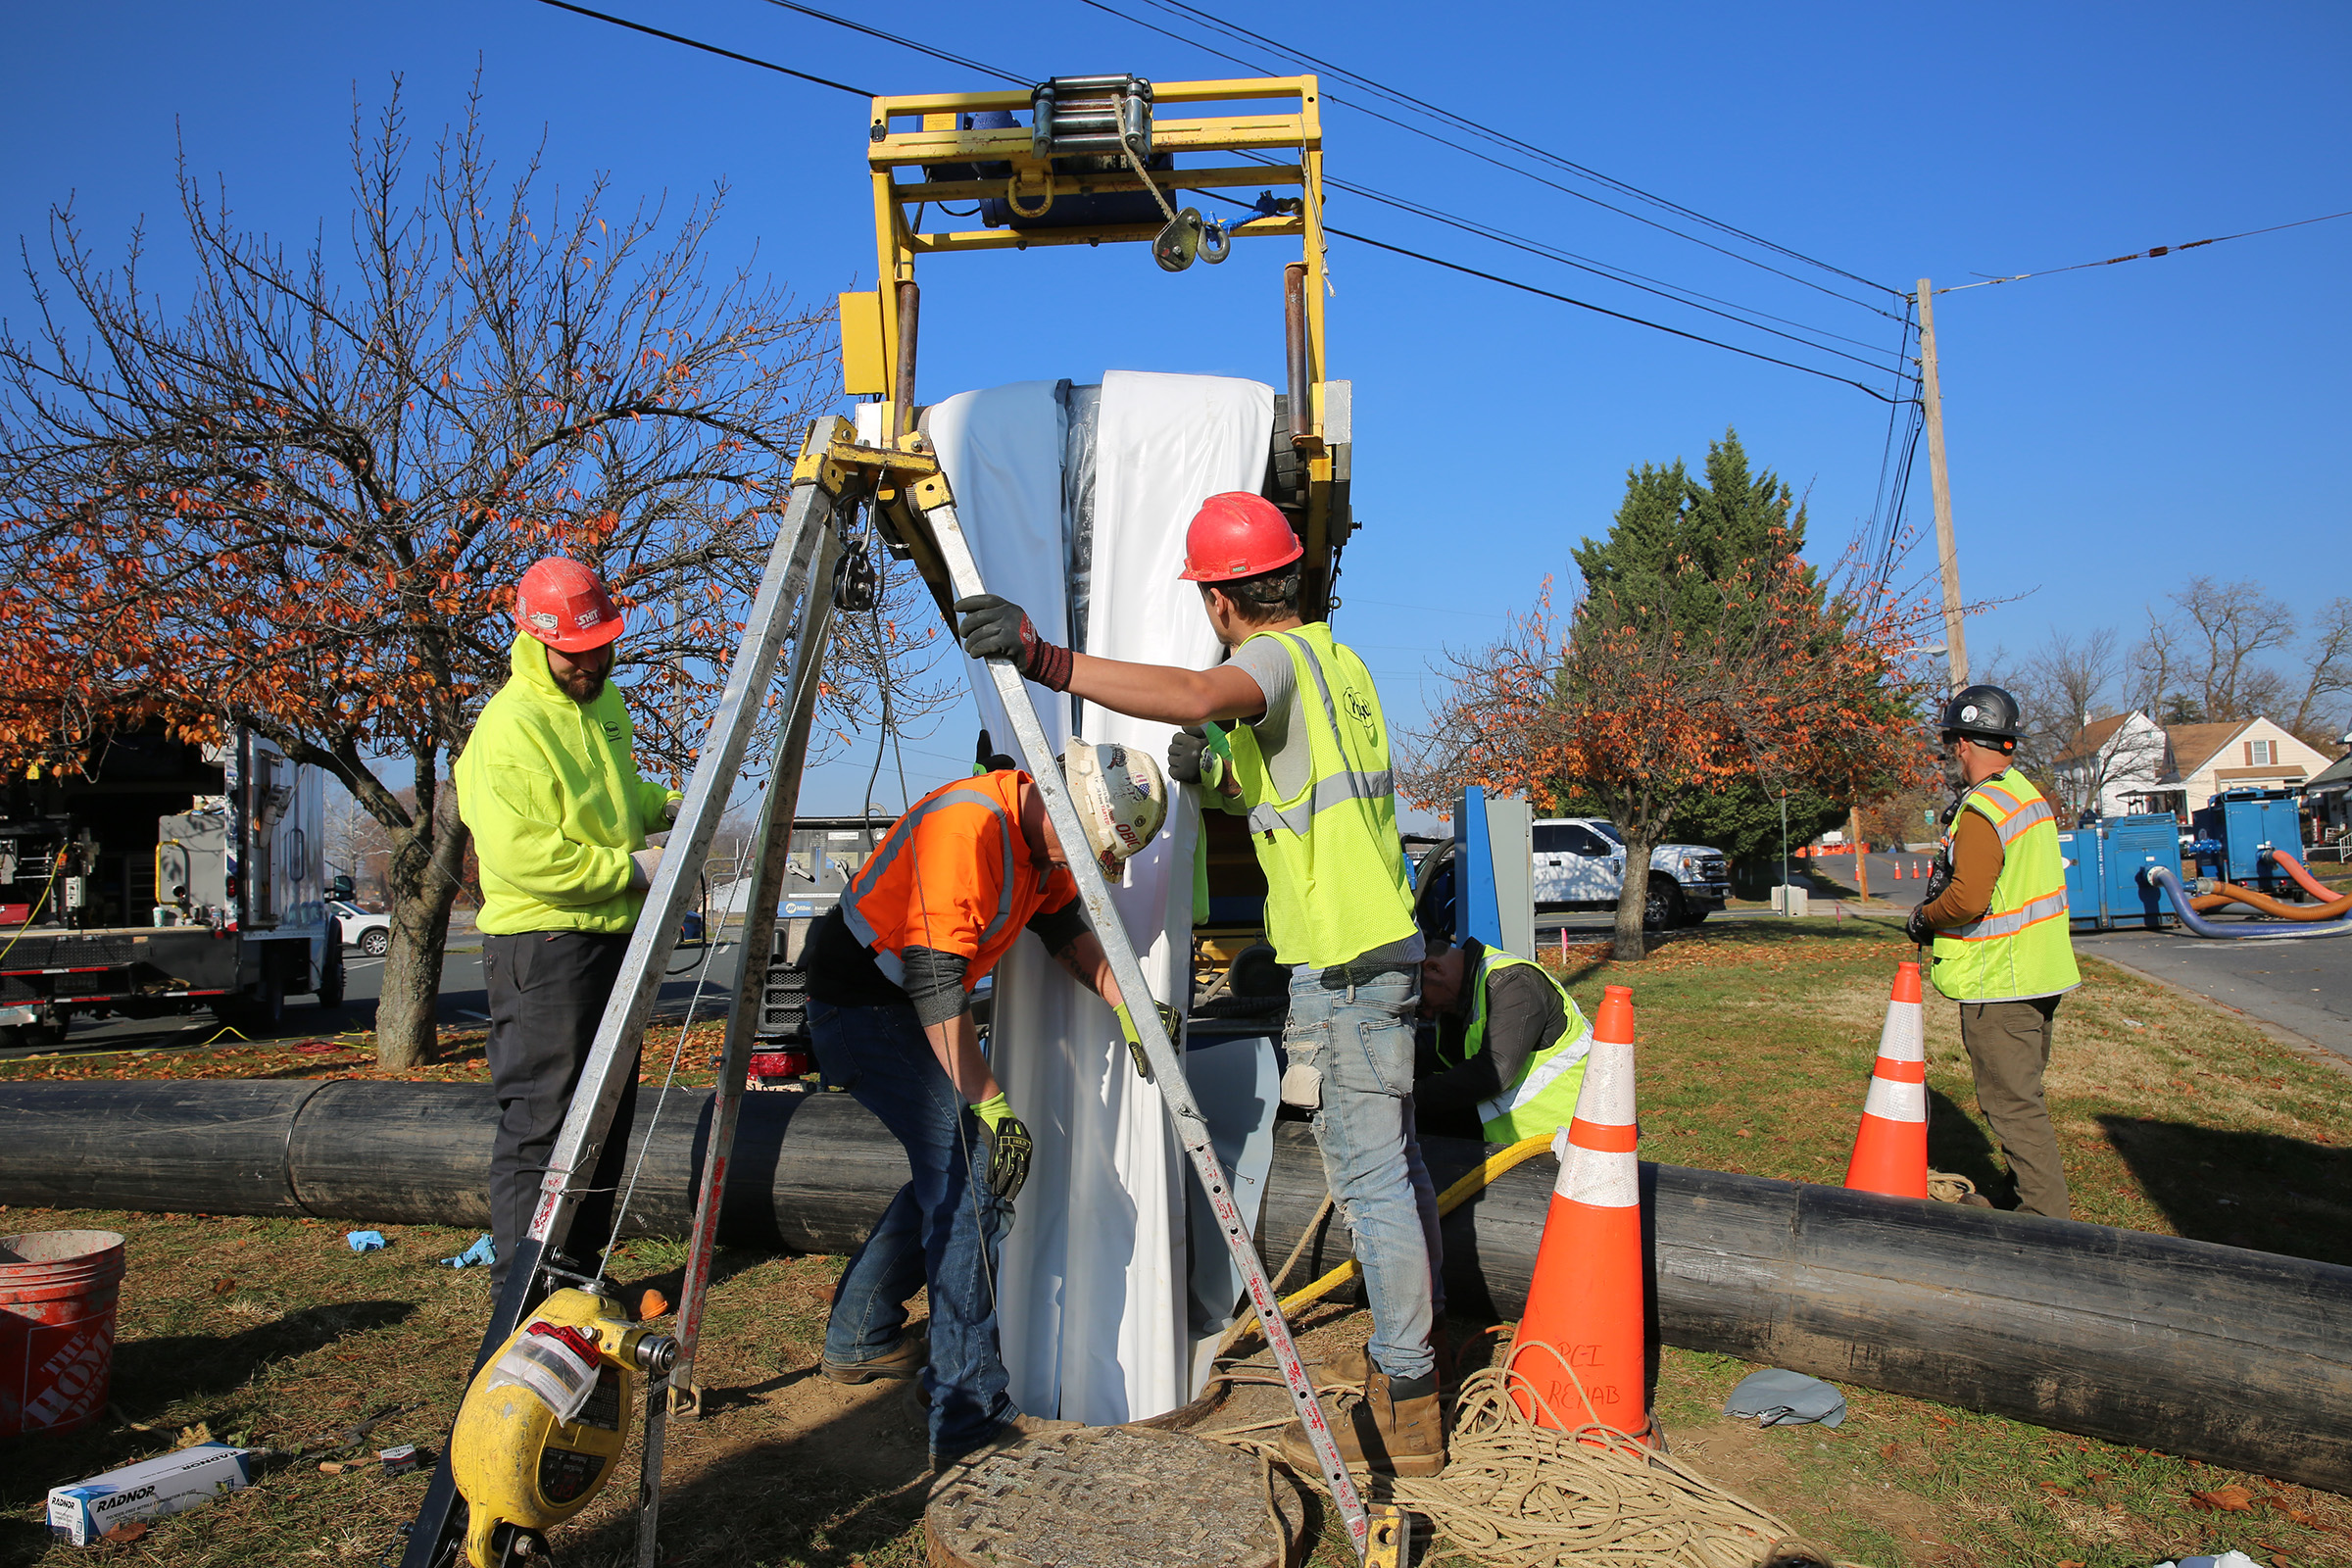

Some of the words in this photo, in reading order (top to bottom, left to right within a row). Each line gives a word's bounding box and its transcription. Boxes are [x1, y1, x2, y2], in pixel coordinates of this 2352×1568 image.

[578, 609, 598, 626] SHIT
[40, 1330, 90, 1375] THE
[569, 1333, 598, 1364] ENCLOSED
[72, 1355, 112, 1416] DEP
[1547, 1380, 1621, 1409] REHAB
[181, 1450, 239, 1471] RADNOR
[51, 1496, 75, 1510] RADNOR
[96, 1485, 156, 1513] RADNOR
